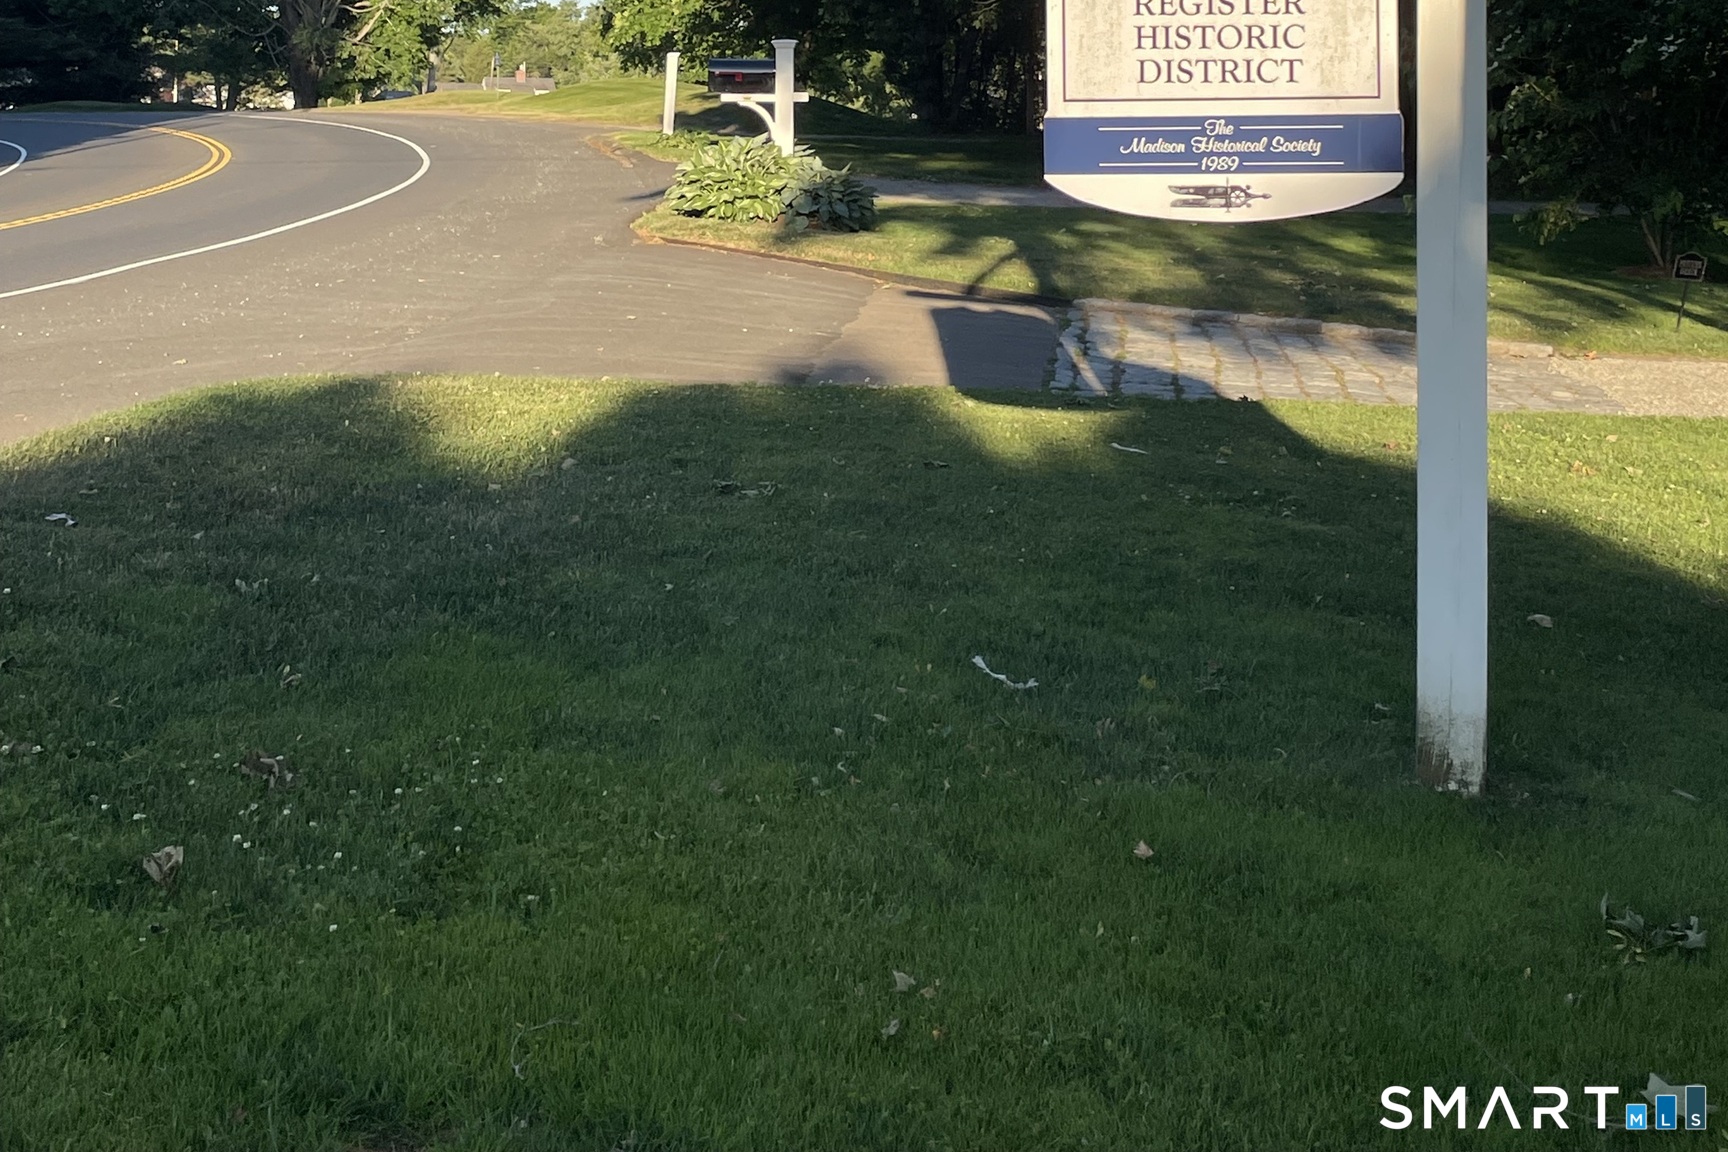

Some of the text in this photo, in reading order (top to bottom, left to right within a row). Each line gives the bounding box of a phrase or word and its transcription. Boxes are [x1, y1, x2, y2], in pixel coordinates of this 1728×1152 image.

[1133, 24, 1306, 50] HISTORIC
[1135, 58, 1304, 84] DISTRICT
[1204, 119, 1234, 136] The
[1119, 135, 1322, 156] Madison Historical Society
[1201, 155, 1239, 171] 1989
